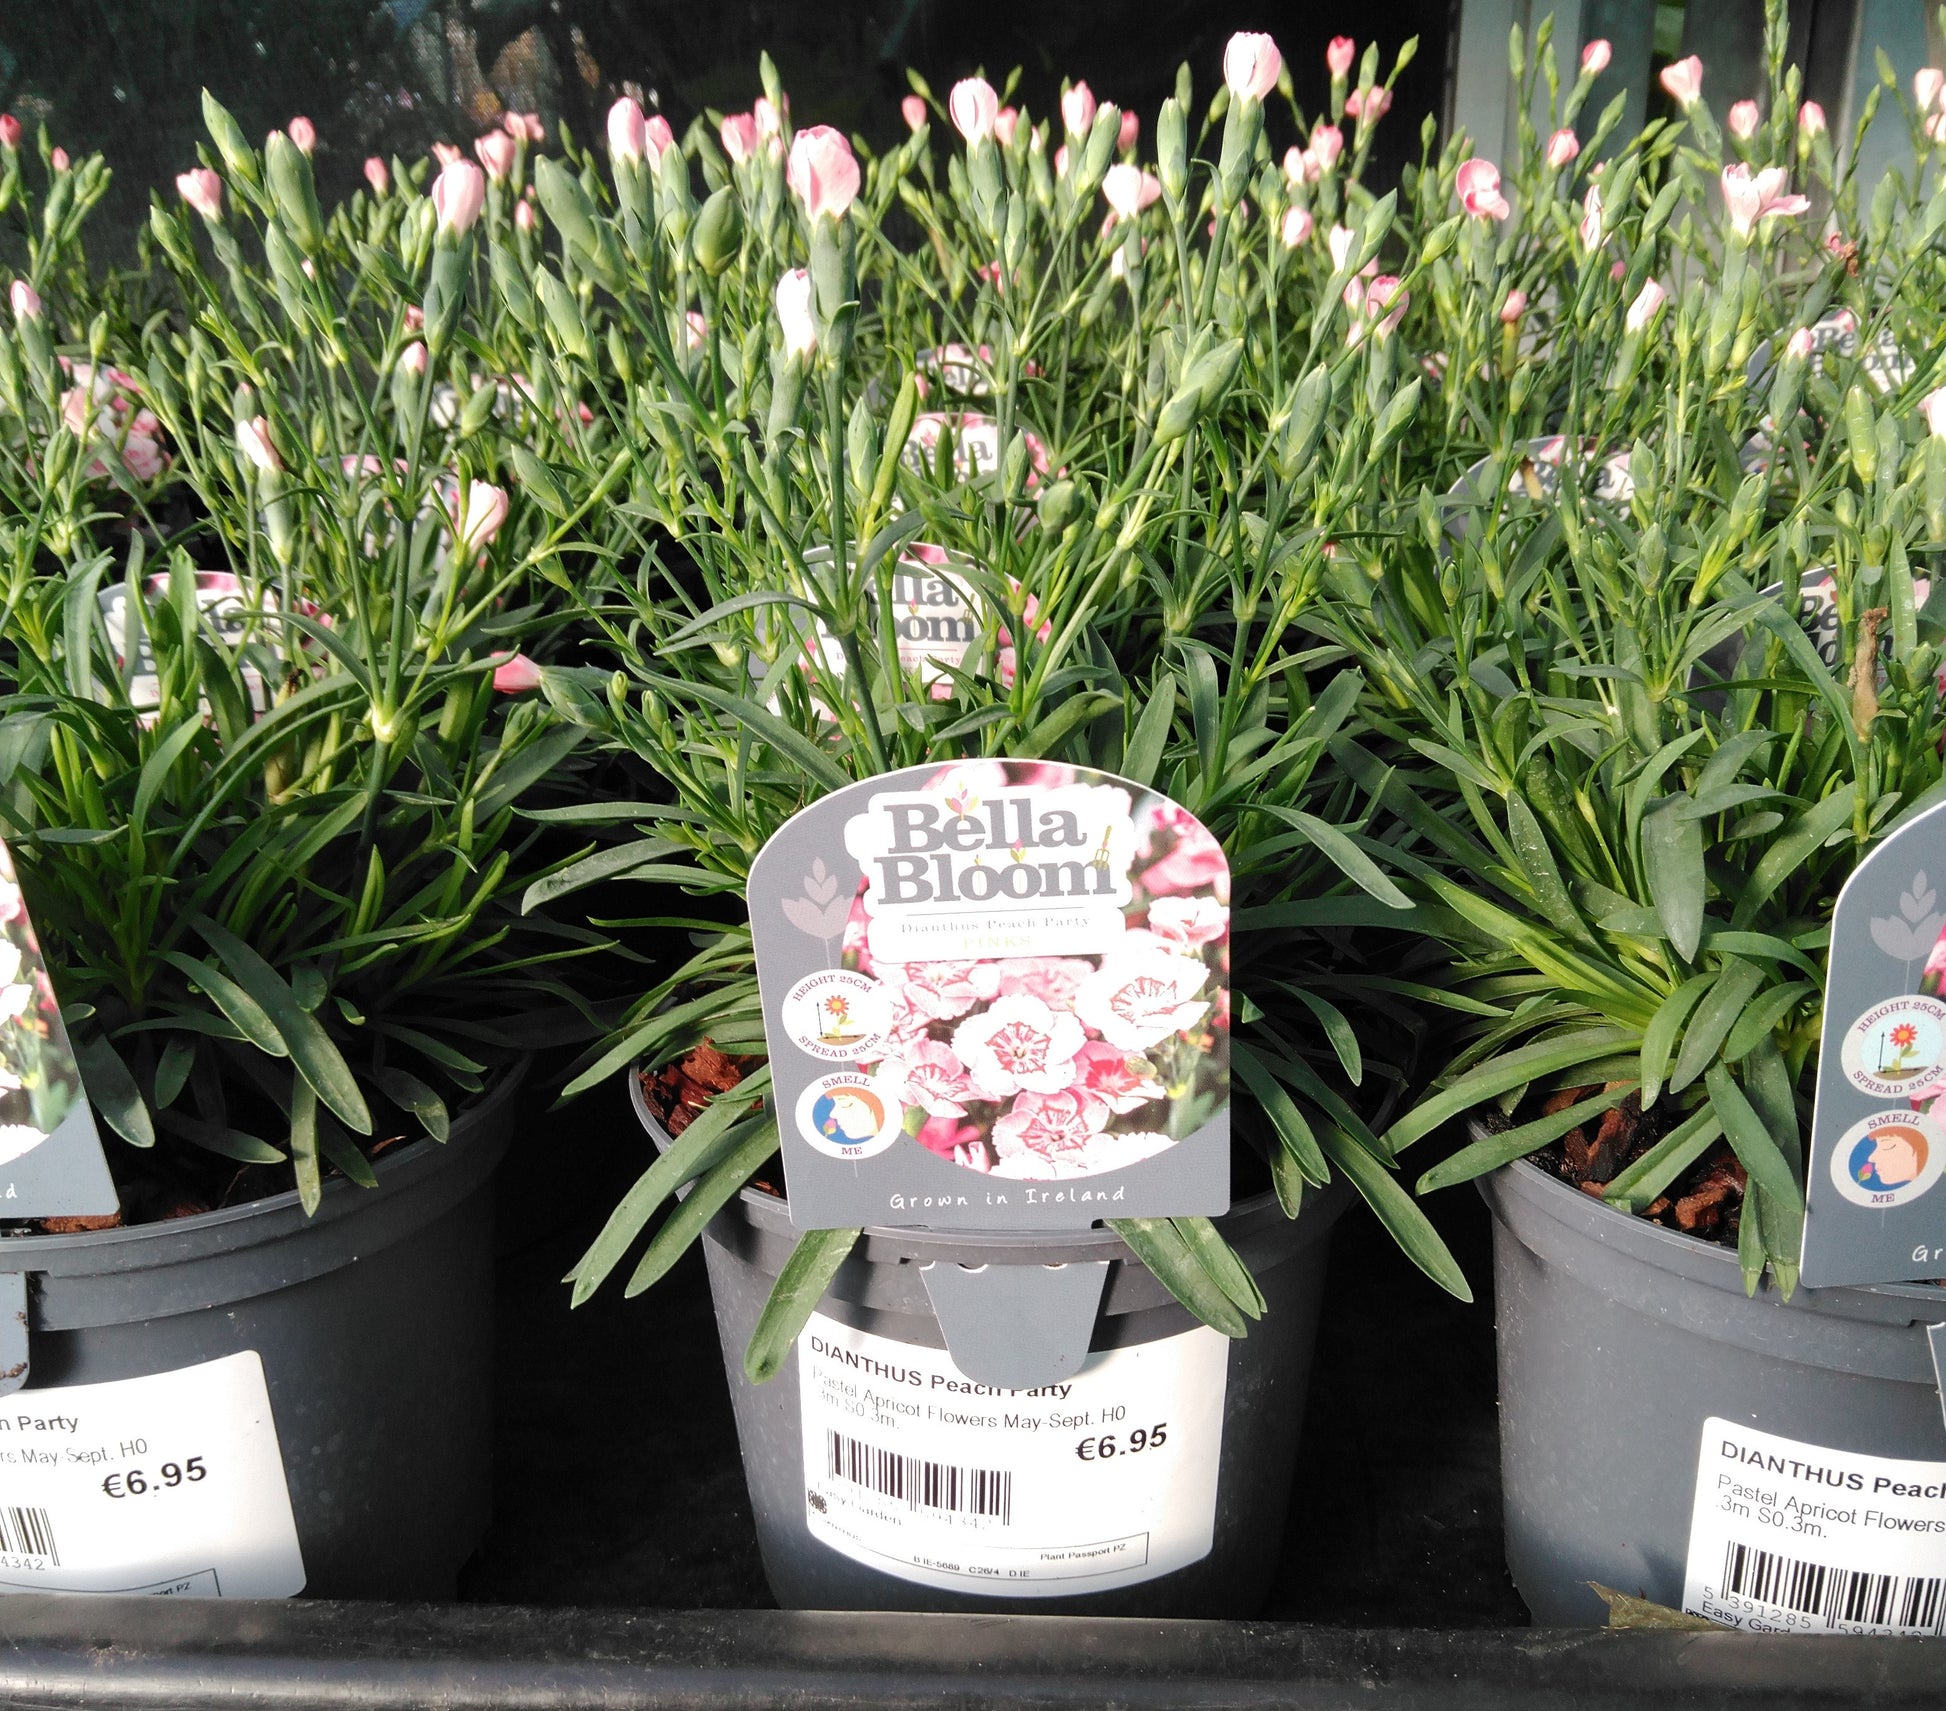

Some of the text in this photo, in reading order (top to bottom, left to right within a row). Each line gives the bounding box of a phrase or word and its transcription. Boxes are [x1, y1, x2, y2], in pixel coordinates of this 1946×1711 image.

[884, 798, 1087, 854] Bella
[874, 853, 1116, 905] Bloom
[901, 916, 1090, 933] Dianthus Peach Party
[793, 975, 873, 1001] HEIGHT 25CM
[1857, 1001, 1946, 1033] HEIGHT 25CM
[798, 1033, 881, 1058] SPREAD 25CM
[822, 1075, 870, 1089] SMELL
[1853, 1065, 1943, 1094] SPREAD 25CM
[1868, 1113, 1920, 1129] SMELL
[841, 1146, 863, 1155] ME
[890, 1186, 1125, 1209] Grown in Ireland
[1871, 1193, 1895, 1203] ME
[811, 1336, 922, 1386] DIANTHUS
[1010, 1384, 1072, 1400] arty
[813, 1365, 857, 1398] Pastel
[863, 1389, 921, 1417] Apricot
[928, 1405, 997, 1428] Flowers
[1004, 1411, 1094, 1432] May-Sept.
[17, 1416, 78, 1433] Party
[1075, 1422, 1168, 1461] €6.95
[21, 1447, 114, 1466] May-Sept.
[1721, 1440, 1864, 1491] DIANTHUS
[101, 1456, 207, 1498] €6.95
[1717, 1473, 1946, 1533] Pastel Apricot Flowers
[1040, 1552, 1065, 1561] Plant
[1069, 1548, 1110, 1560] Passport
[1702, 1601, 1744, 1627] Easy
[1728, 1596, 1811, 1629] 391285
